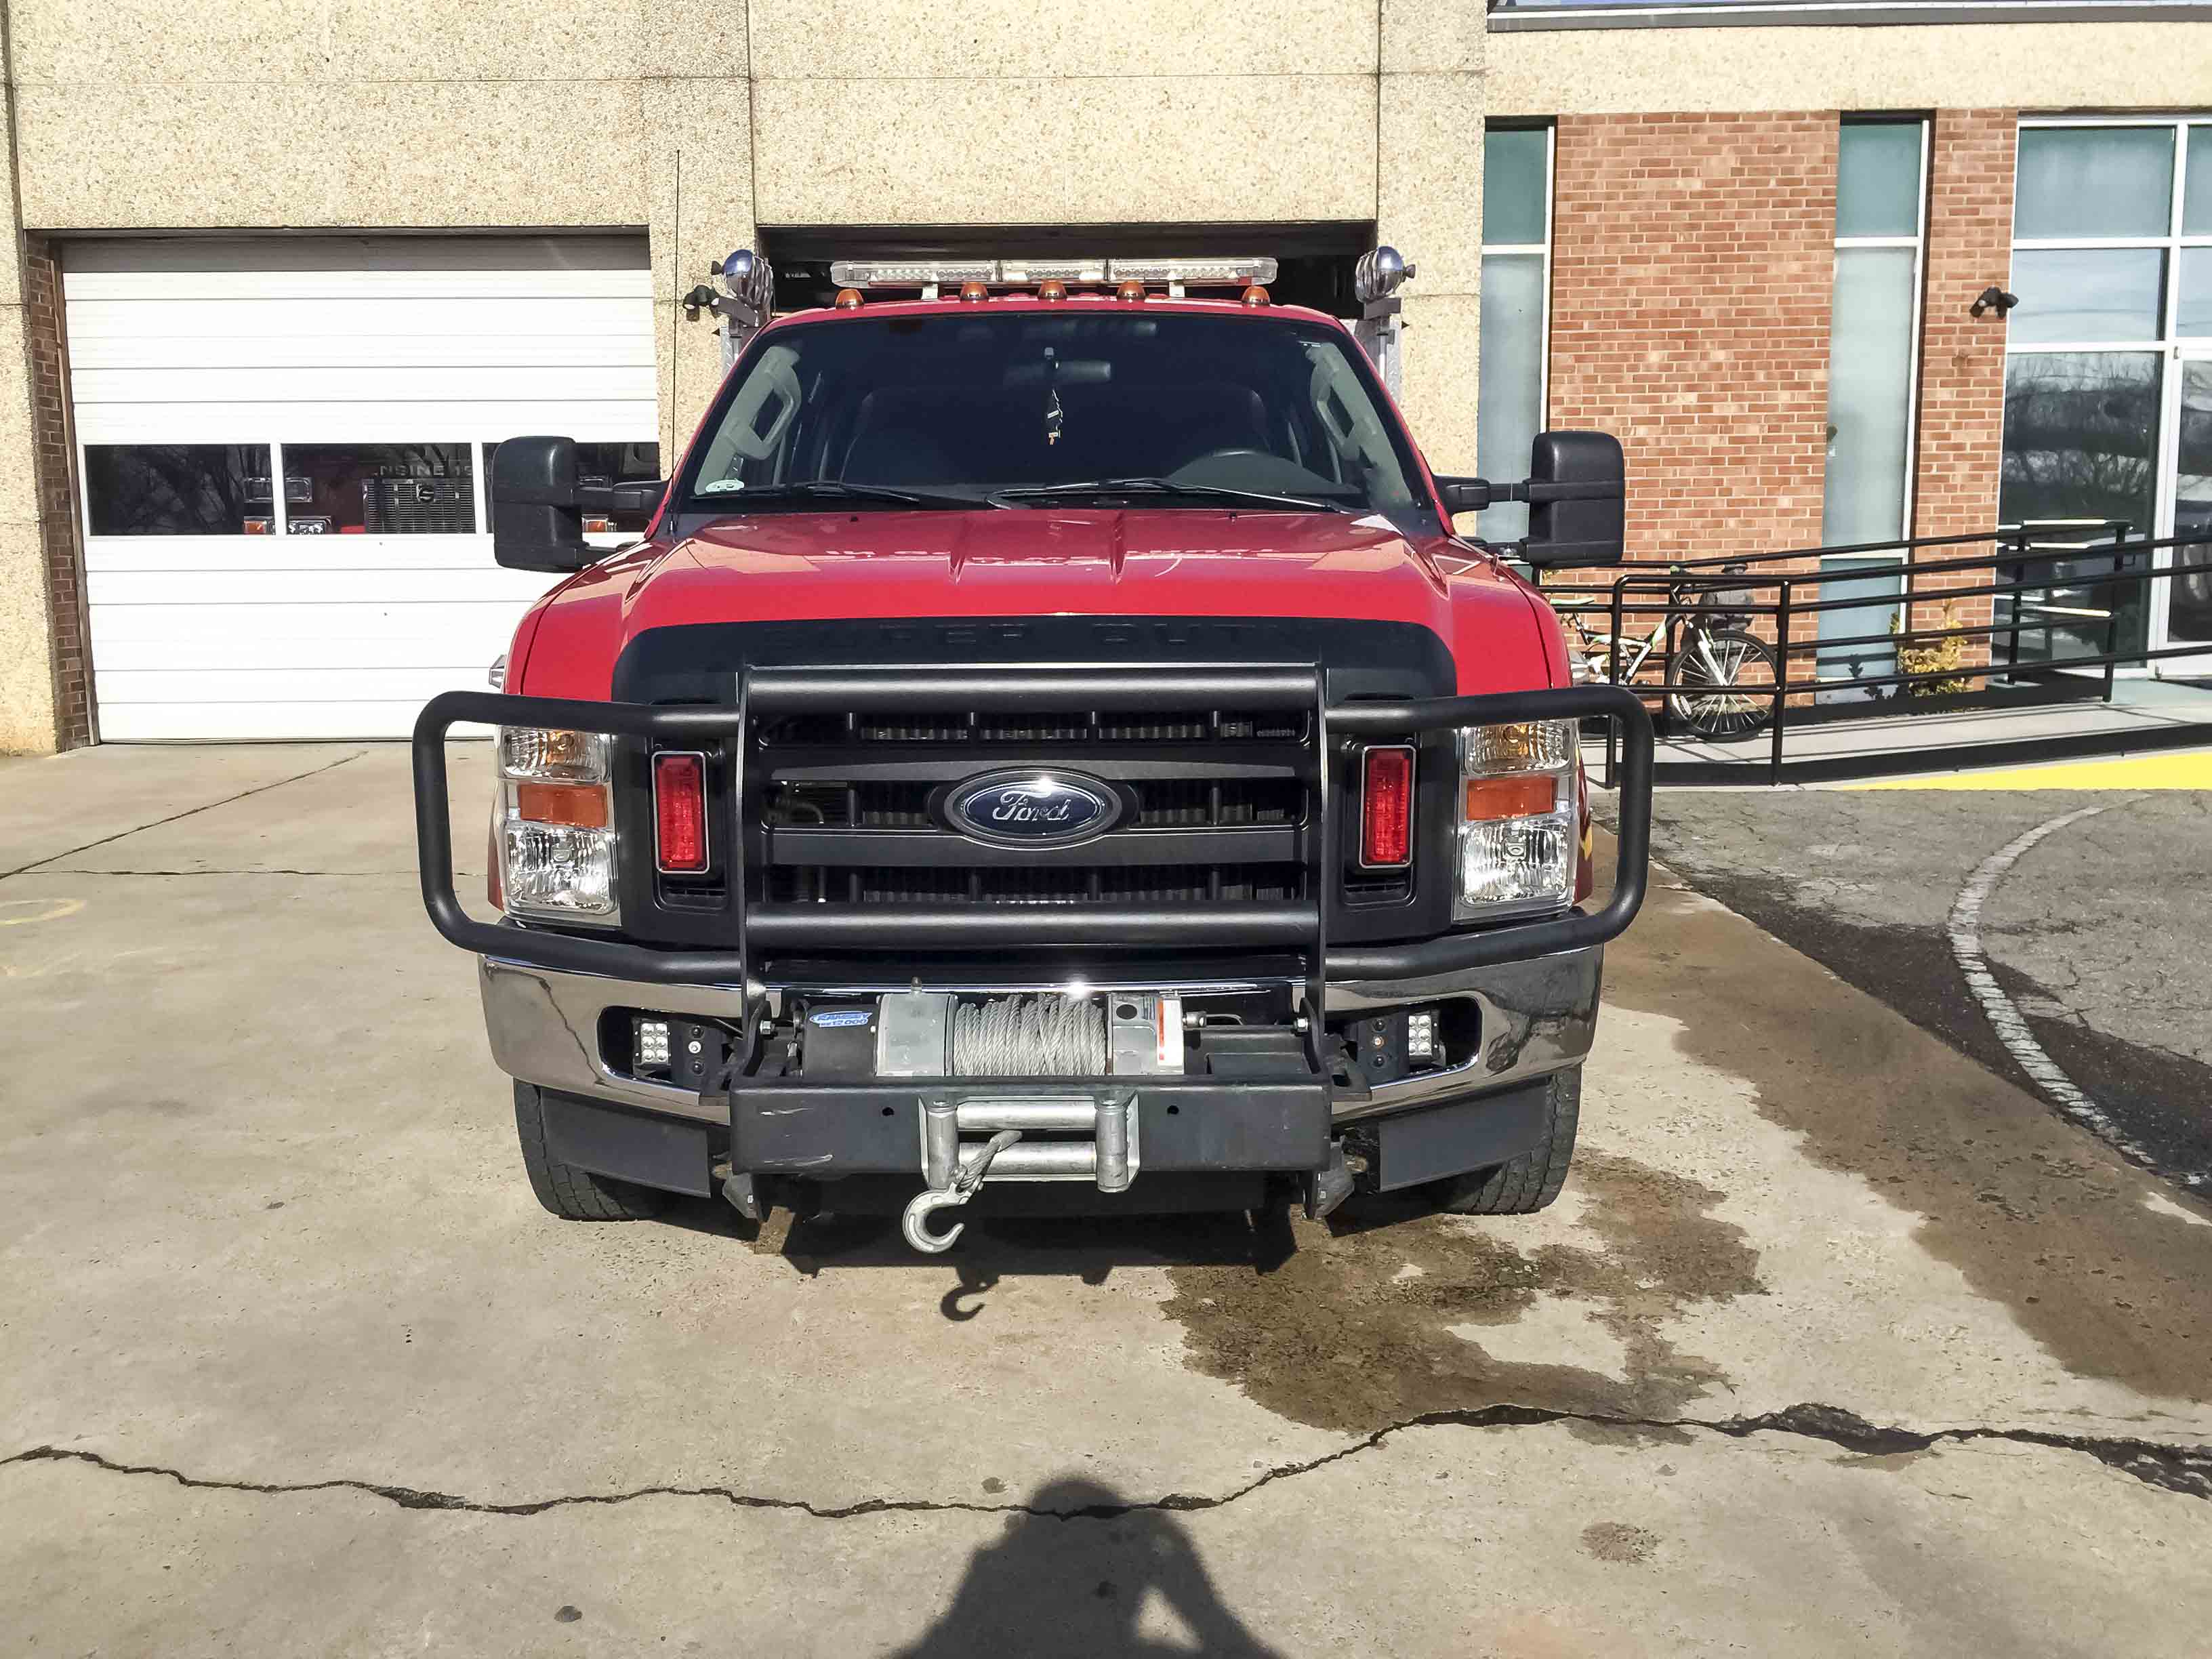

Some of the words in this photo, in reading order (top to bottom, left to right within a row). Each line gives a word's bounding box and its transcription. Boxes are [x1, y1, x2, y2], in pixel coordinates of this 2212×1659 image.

[371, 466, 445, 476] NGINE
[764, 622, 1027, 646] PER
[992, 790, 1071, 821] Ford
